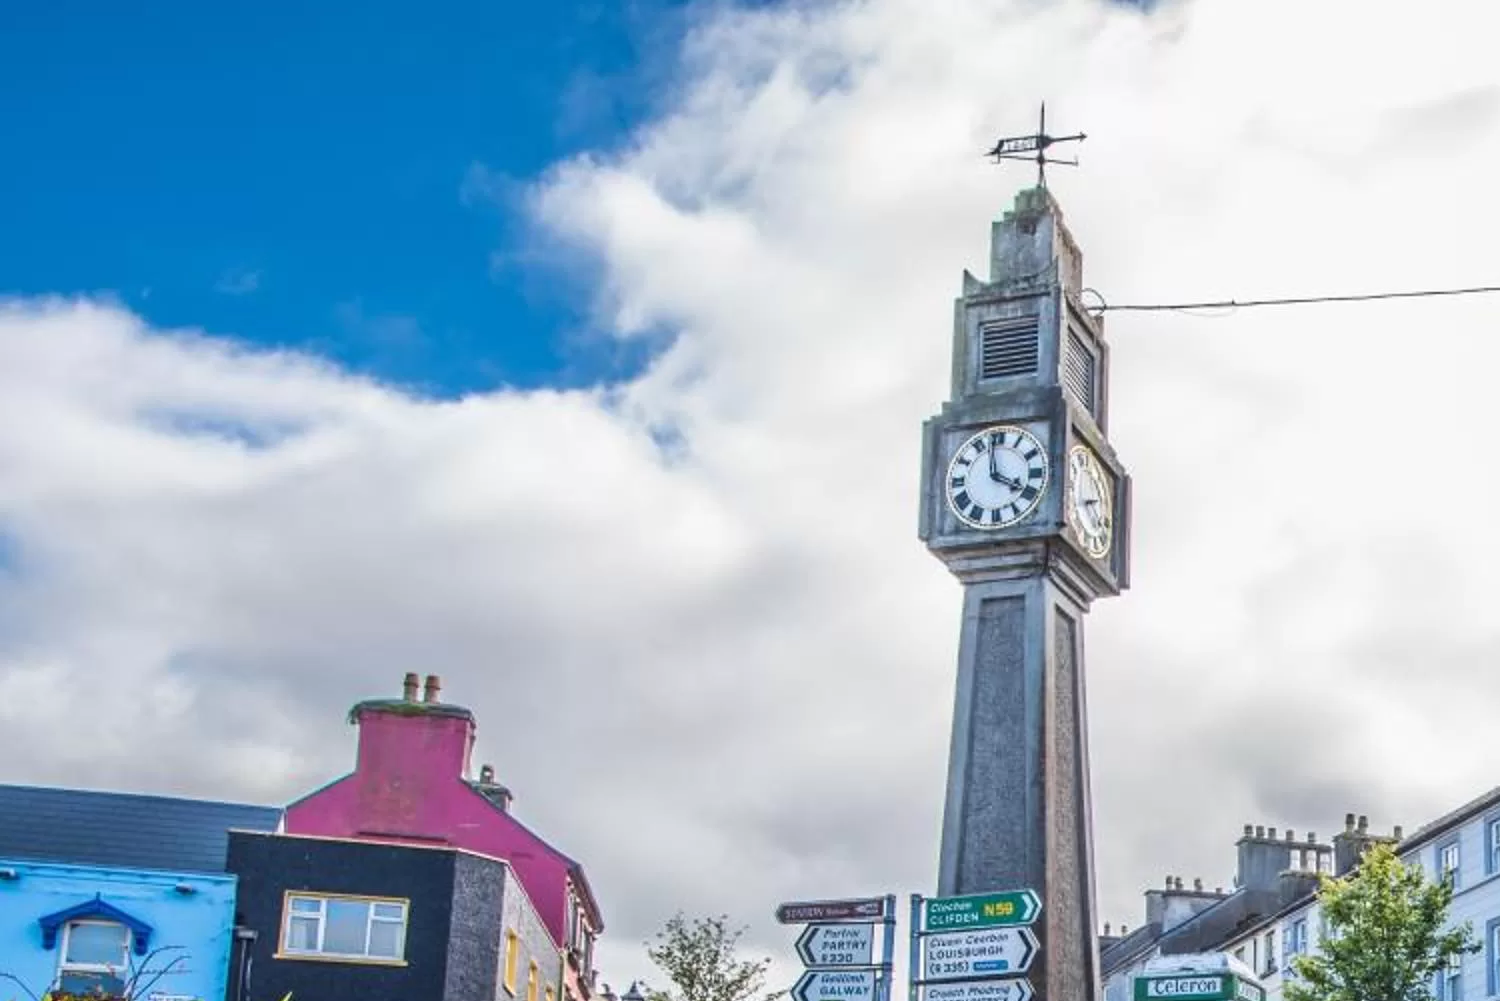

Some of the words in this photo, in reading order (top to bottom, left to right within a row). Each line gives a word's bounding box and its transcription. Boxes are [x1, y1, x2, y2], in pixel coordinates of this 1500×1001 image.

[984, 902, 1013, 916] N59
[930, 913, 979, 925] CLIFDEN
[930, 947, 1003, 960] LOUISBURGH
[820, 986, 869, 995] GALWAY
